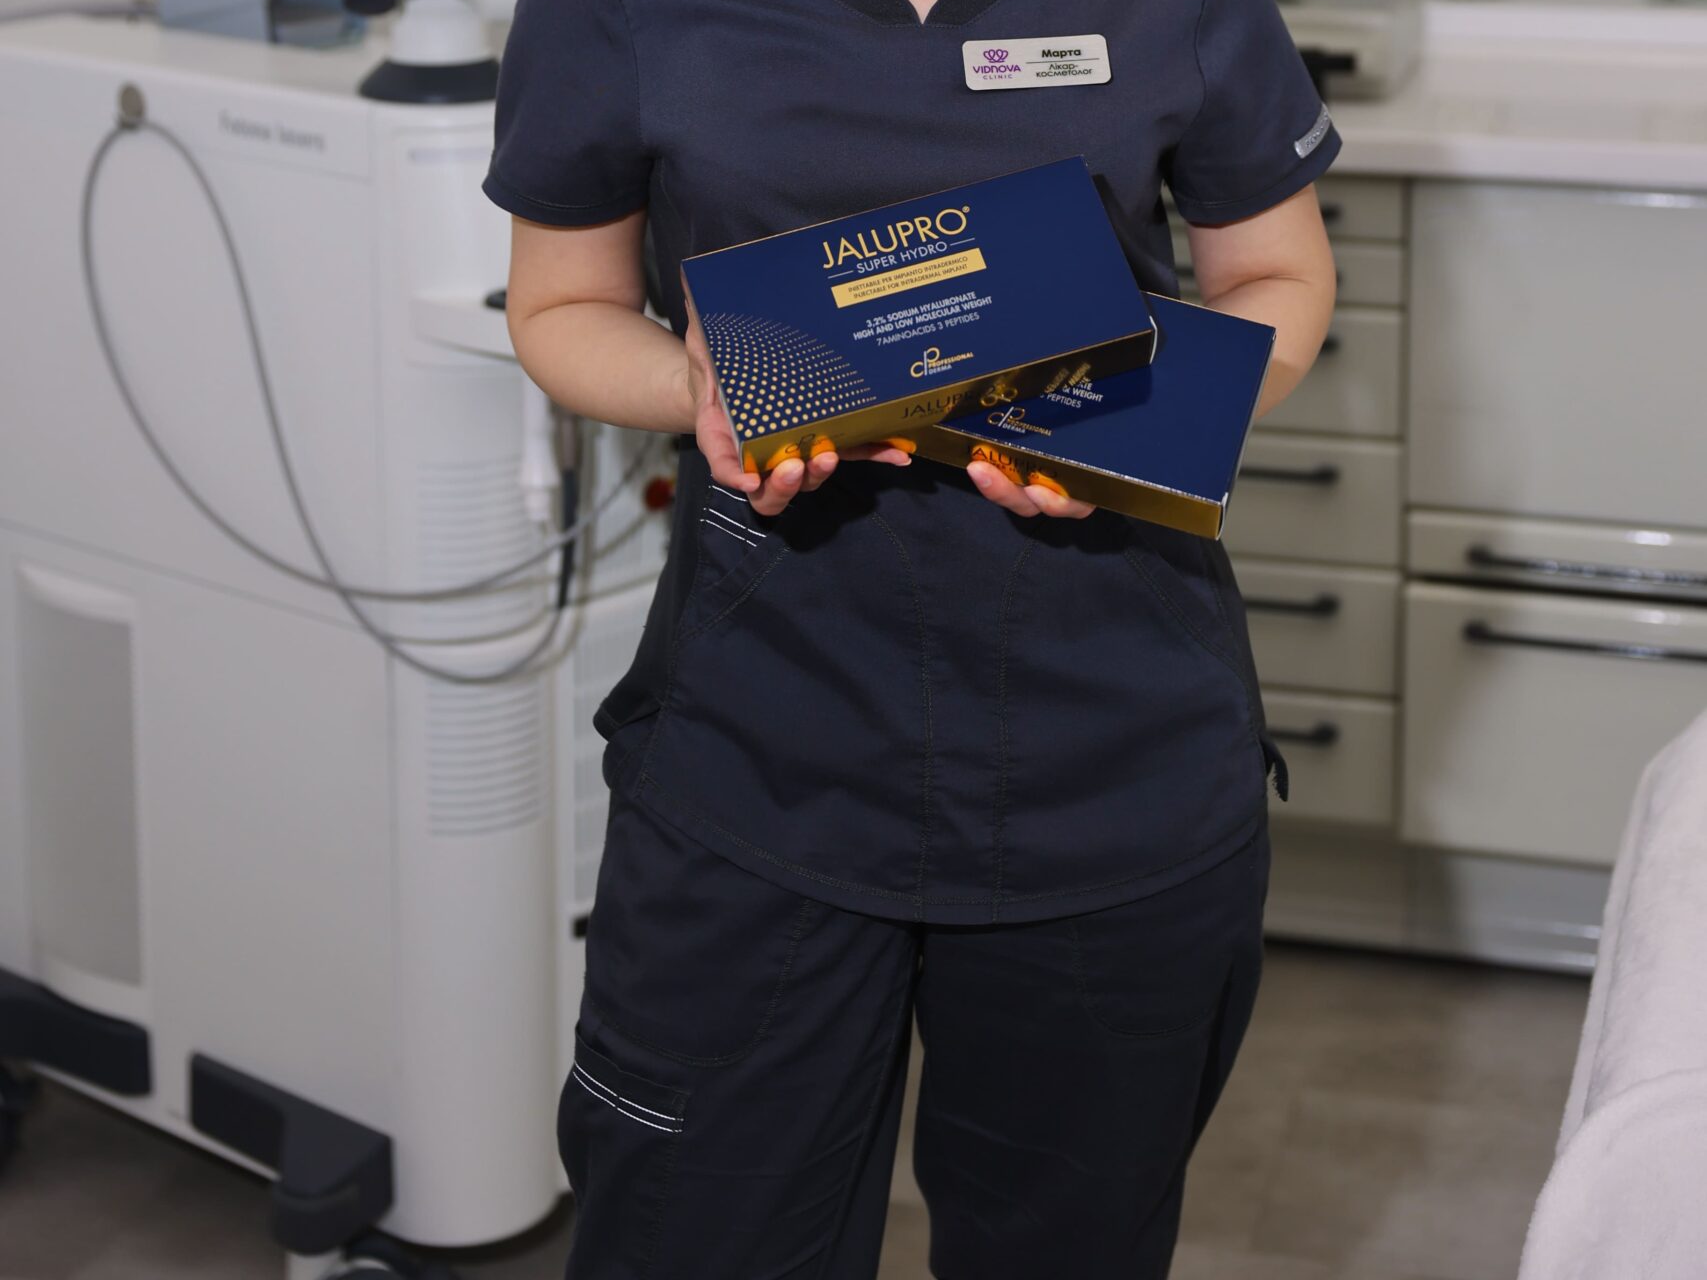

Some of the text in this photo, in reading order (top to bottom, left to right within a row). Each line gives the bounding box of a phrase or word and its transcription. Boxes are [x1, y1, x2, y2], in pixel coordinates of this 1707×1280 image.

[1041, 49, 1082, 59] Марта
[973, 64, 1022, 74] VIDNOVA
[1036, 68, 1093, 78] косметолог
[856, 241, 948, 274] SUPER HYDRO
[882, 276, 893, 285] PER
[893, 268, 923, 281] IMPIANTO
[924, 256, 968, 272] INTRADERMICO
[853, 264, 968, 299] INJECTABLE FOR INTRADERMAL IMPLANT
[887, 307, 919, 322] SODIUM
[920, 291, 977, 313] HYALURONATE
[853, 296, 992, 341] HIGH AND LOW MOLECULAR WEIGHT
[938, 321, 944, 331] 3
[945, 311, 980, 328] PEPTIDES
[928, 351, 974, 368] PROFESSIONAL
[928, 364, 952, 375] DERMA
[1046, 392, 1082, 409] PEPTIDES
[1072, 387, 1104, 403] WEIGHT
